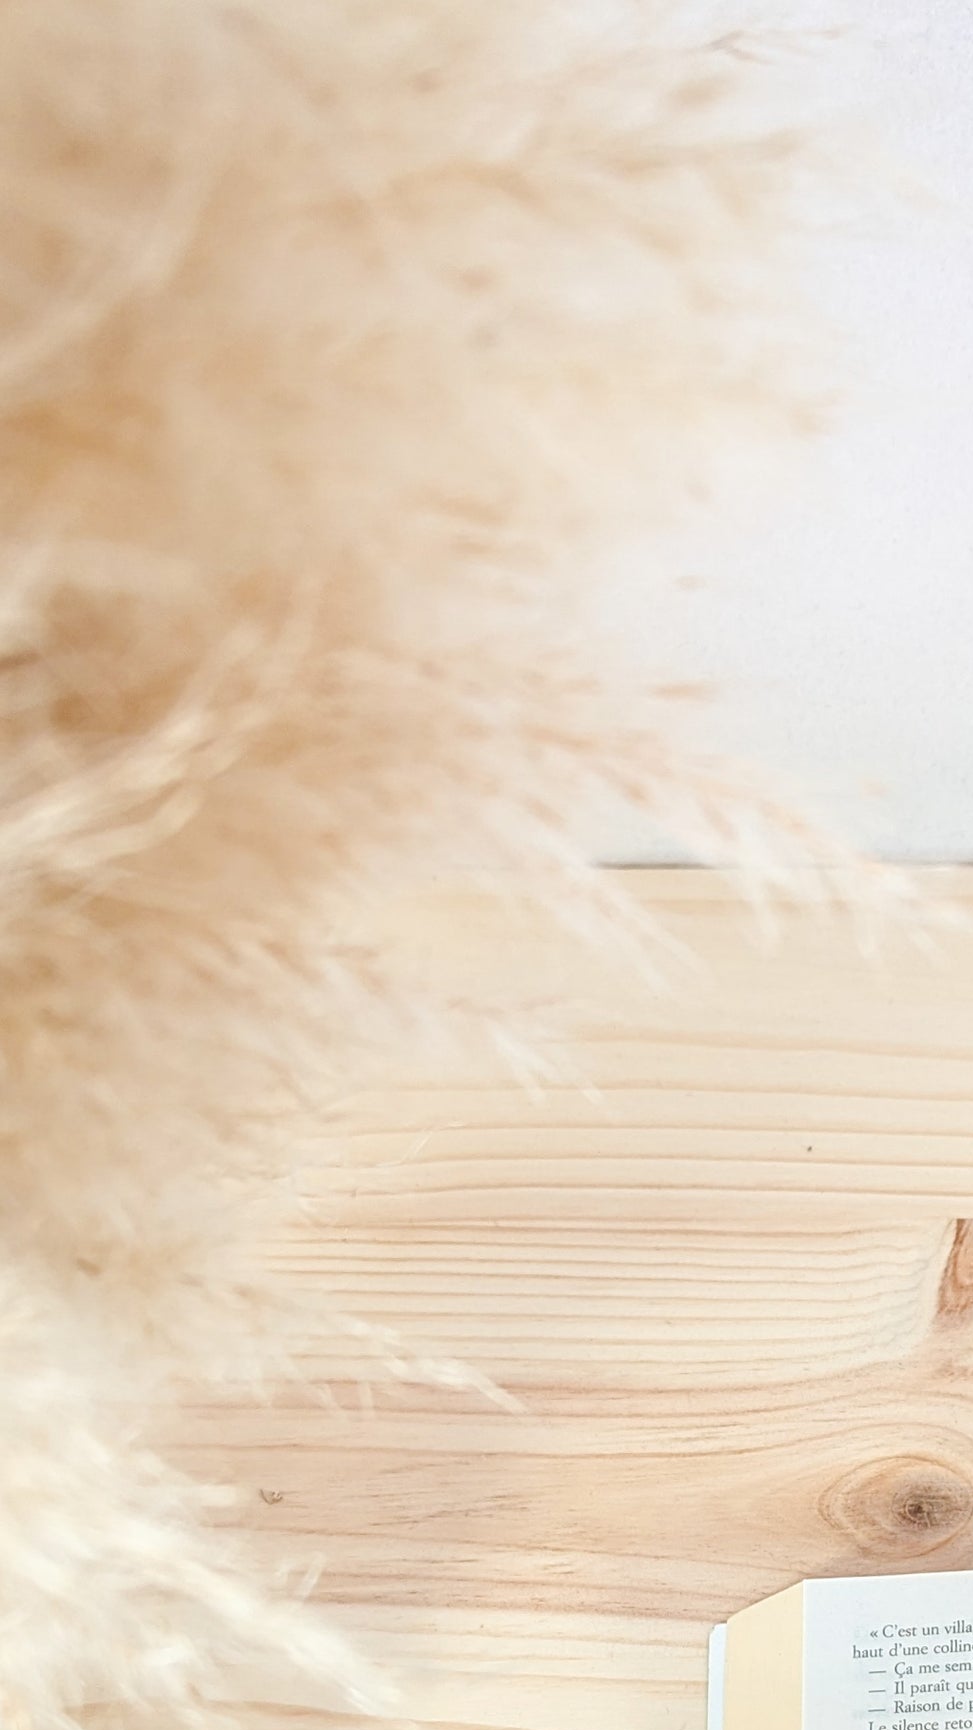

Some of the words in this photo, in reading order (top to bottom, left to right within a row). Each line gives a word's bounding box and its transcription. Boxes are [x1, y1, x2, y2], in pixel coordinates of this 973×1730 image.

[882, 1624, 917, 1639] C'est
[921, 1626, 940, 1637] un
[852, 1644, 884, 1659] haut
[888, 1642, 929, 1657] d'une
[894, 1661, 914, 1679] Ça
[918, 1664, 941, 1674] me
[894, 1680, 905, 1695] Il
[910, 1678, 950, 1698] paraît
[893, 1699, 941, 1714] Raison
[945, 1696, 964, 1711] de
